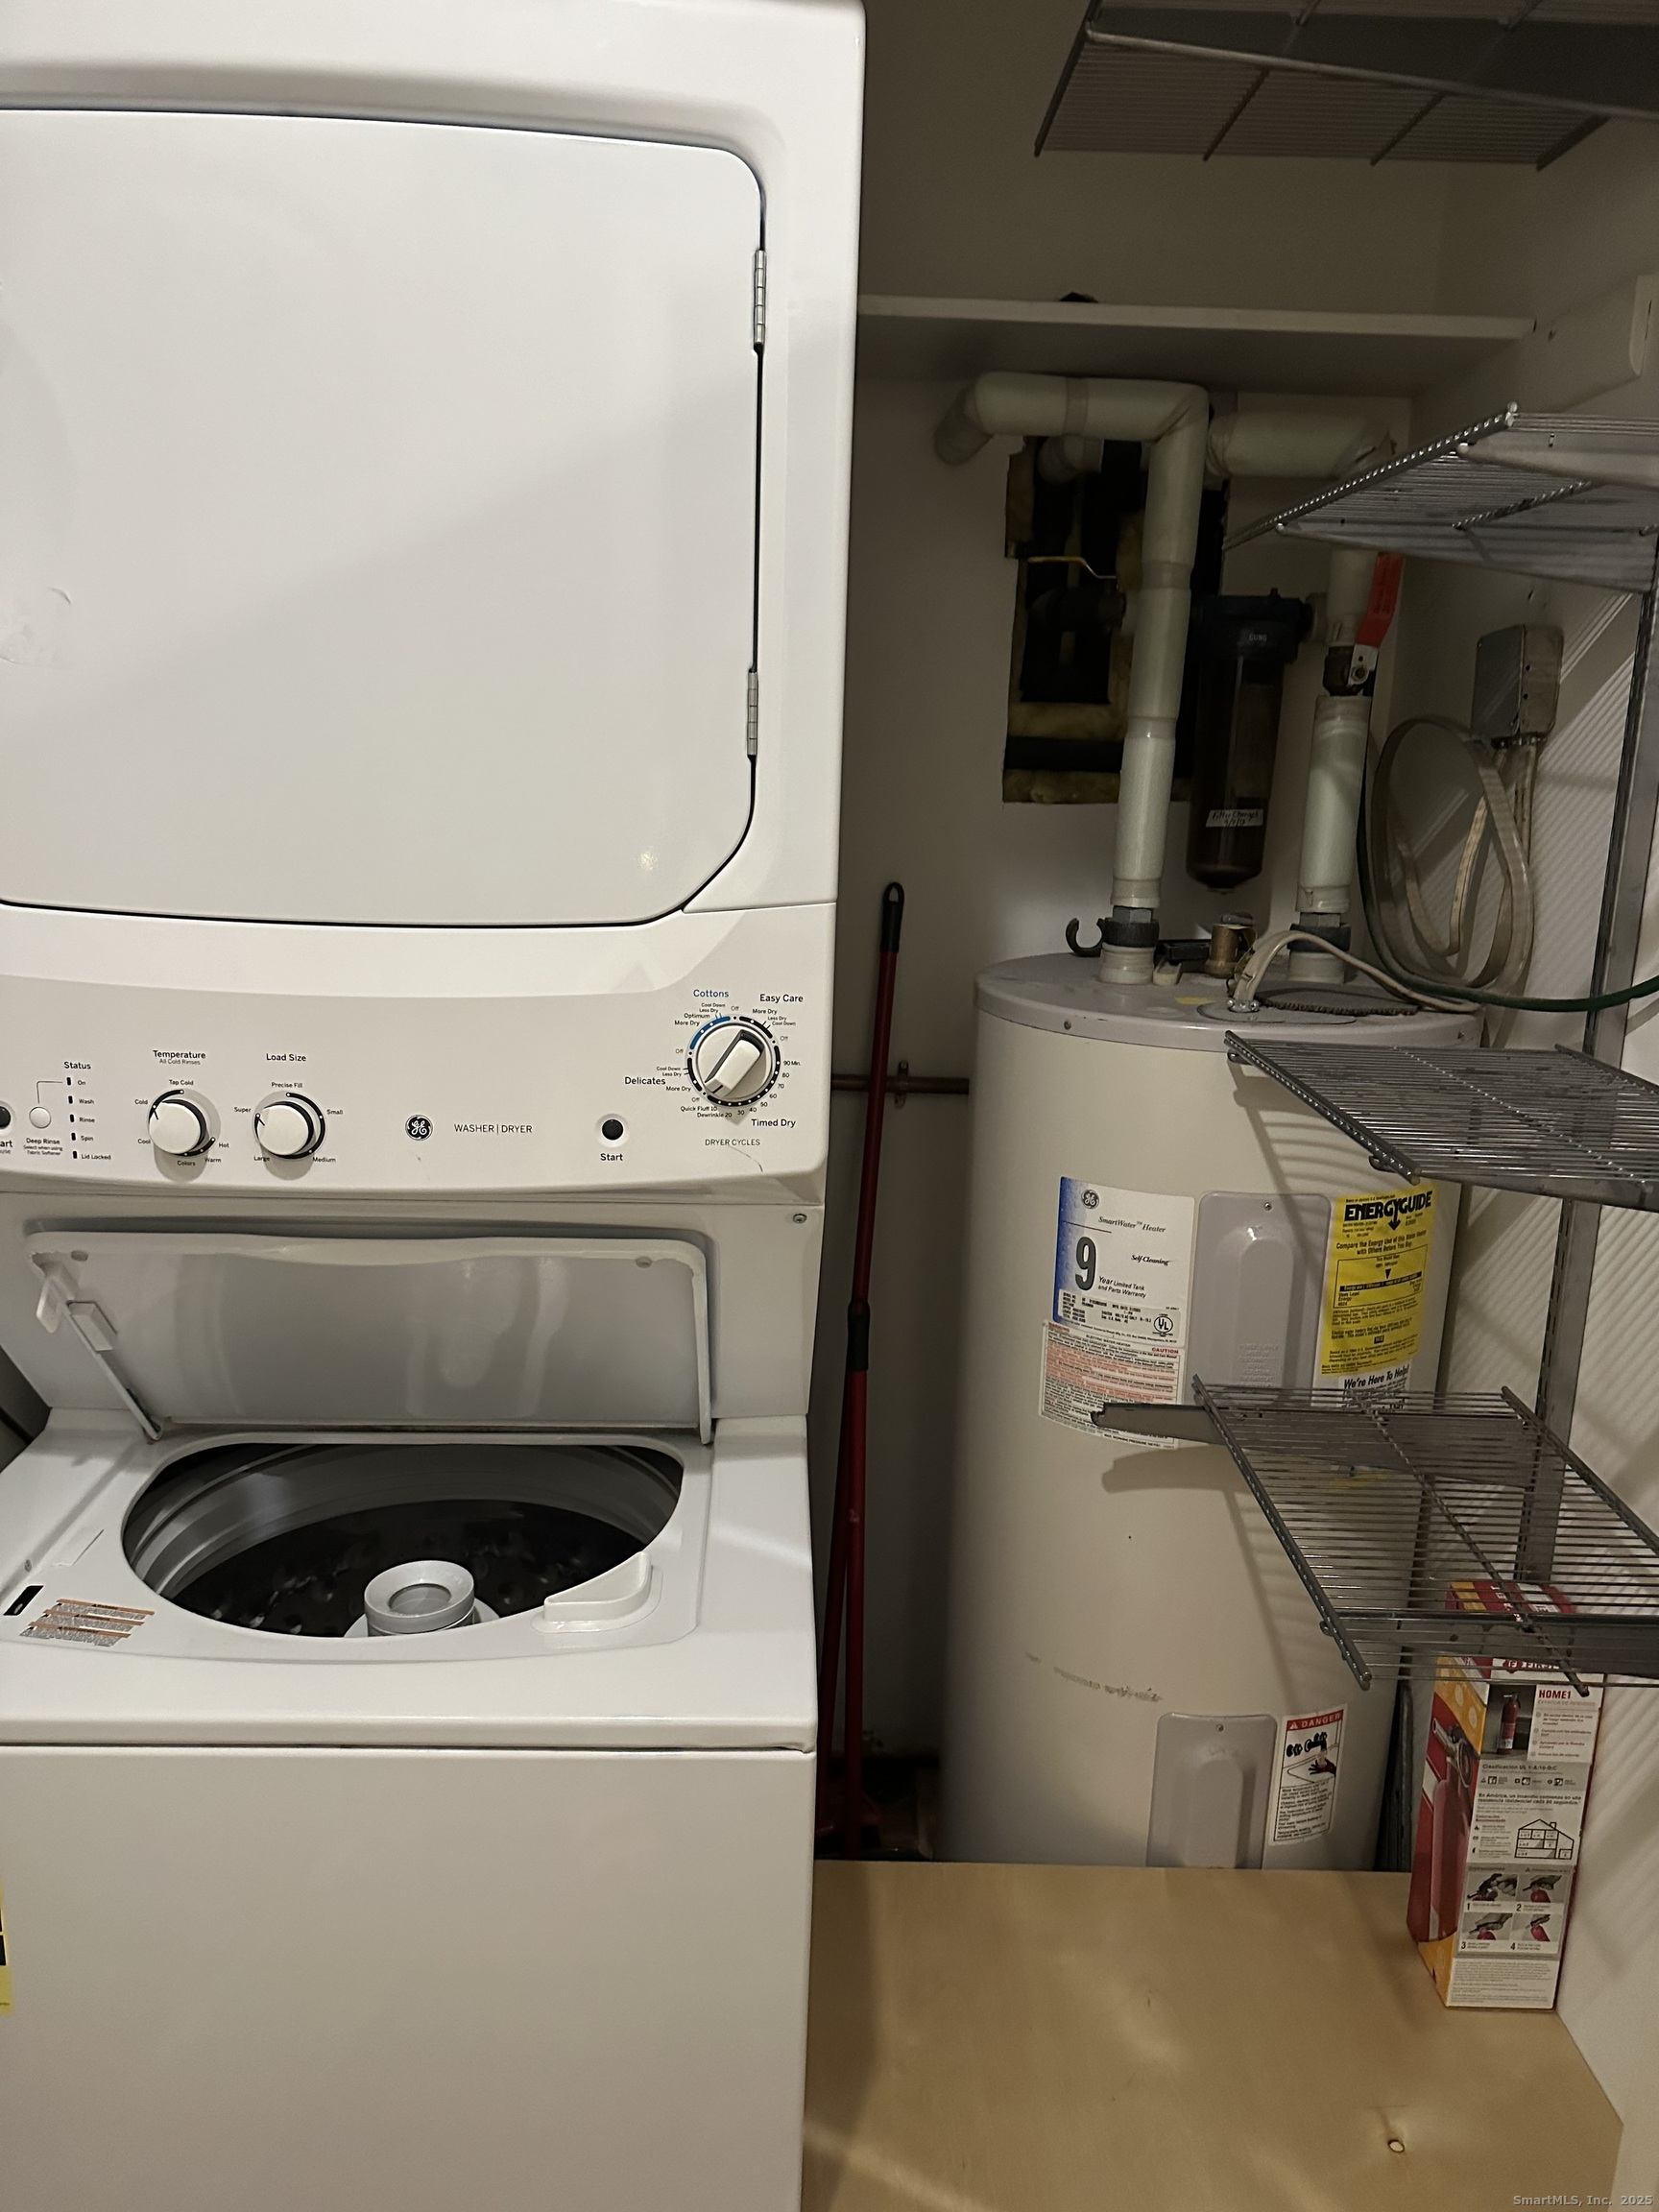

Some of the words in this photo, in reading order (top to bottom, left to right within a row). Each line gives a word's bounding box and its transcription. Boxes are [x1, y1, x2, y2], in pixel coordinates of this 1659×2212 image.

[759, 995, 780, 1003] Easy
[153, 1050, 205, 1061] Temperature
[63, 1061, 91, 1070] Status
[624, 1076, 666, 1085] Delicates
[454, 1123, 494, 1133] WASHER
[501, 1125, 532, 1134] DRYER
[751, 1118, 779, 1127] Timed
[781, 1119, 797, 1129] Dry
[1344, 1190, 1433, 1222] ENERGYGUIDE
[1142, 1224, 1166, 1233] Heater
[1074, 1236, 1096, 1290] 9
[1098, 1276, 1113, 1285] Year
[1114, 1280, 1132, 1288] Limited
[1122, 1288, 1146, 1299] Warranty
[1344, 1379, 1365, 1389] We're
[1368, 1375, 1384, 1384] Here
[1386, 1371, 1393, 1381] To
[1539, 1690, 1572, 1699] HOME1
[1301, 1713, 1341, 1728] DANGER
[1516, 1903, 1522, 1911] 2
